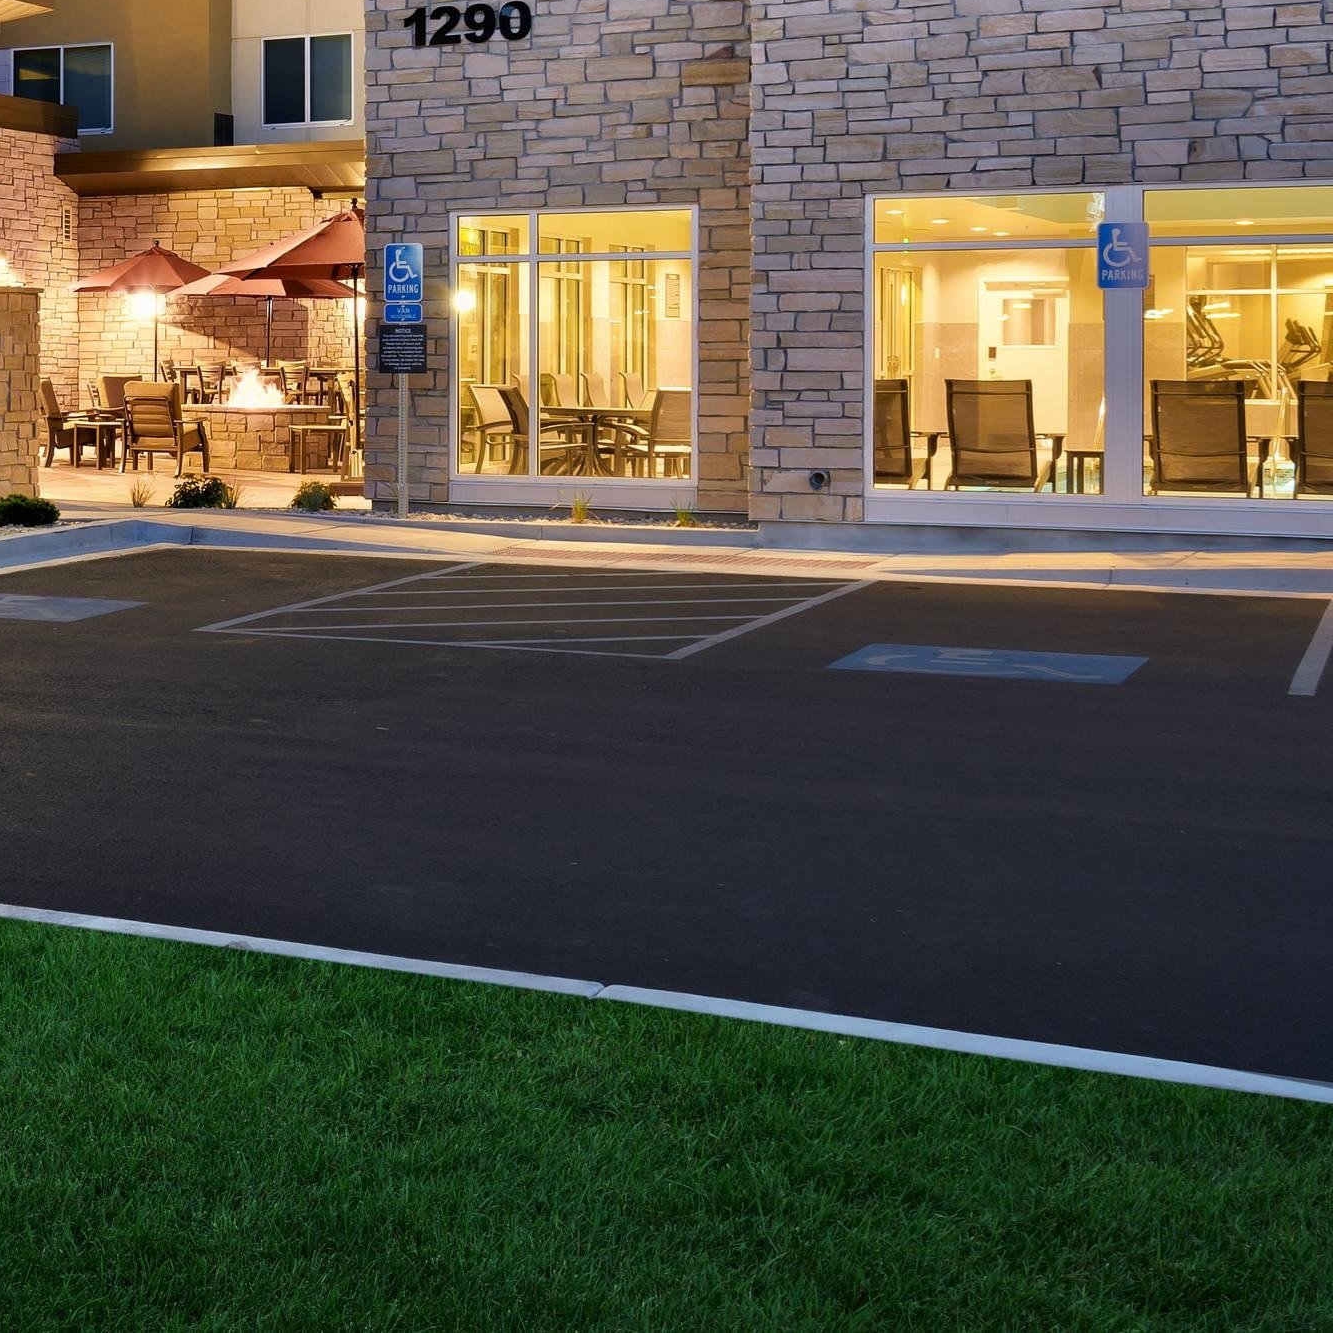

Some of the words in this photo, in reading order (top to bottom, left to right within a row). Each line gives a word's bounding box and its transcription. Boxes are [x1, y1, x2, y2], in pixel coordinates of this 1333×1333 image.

[404, 0, 532, 47] 1290
[1101, 269, 1144, 281] PARKING
[387, 284, 419, 294] PARKING
